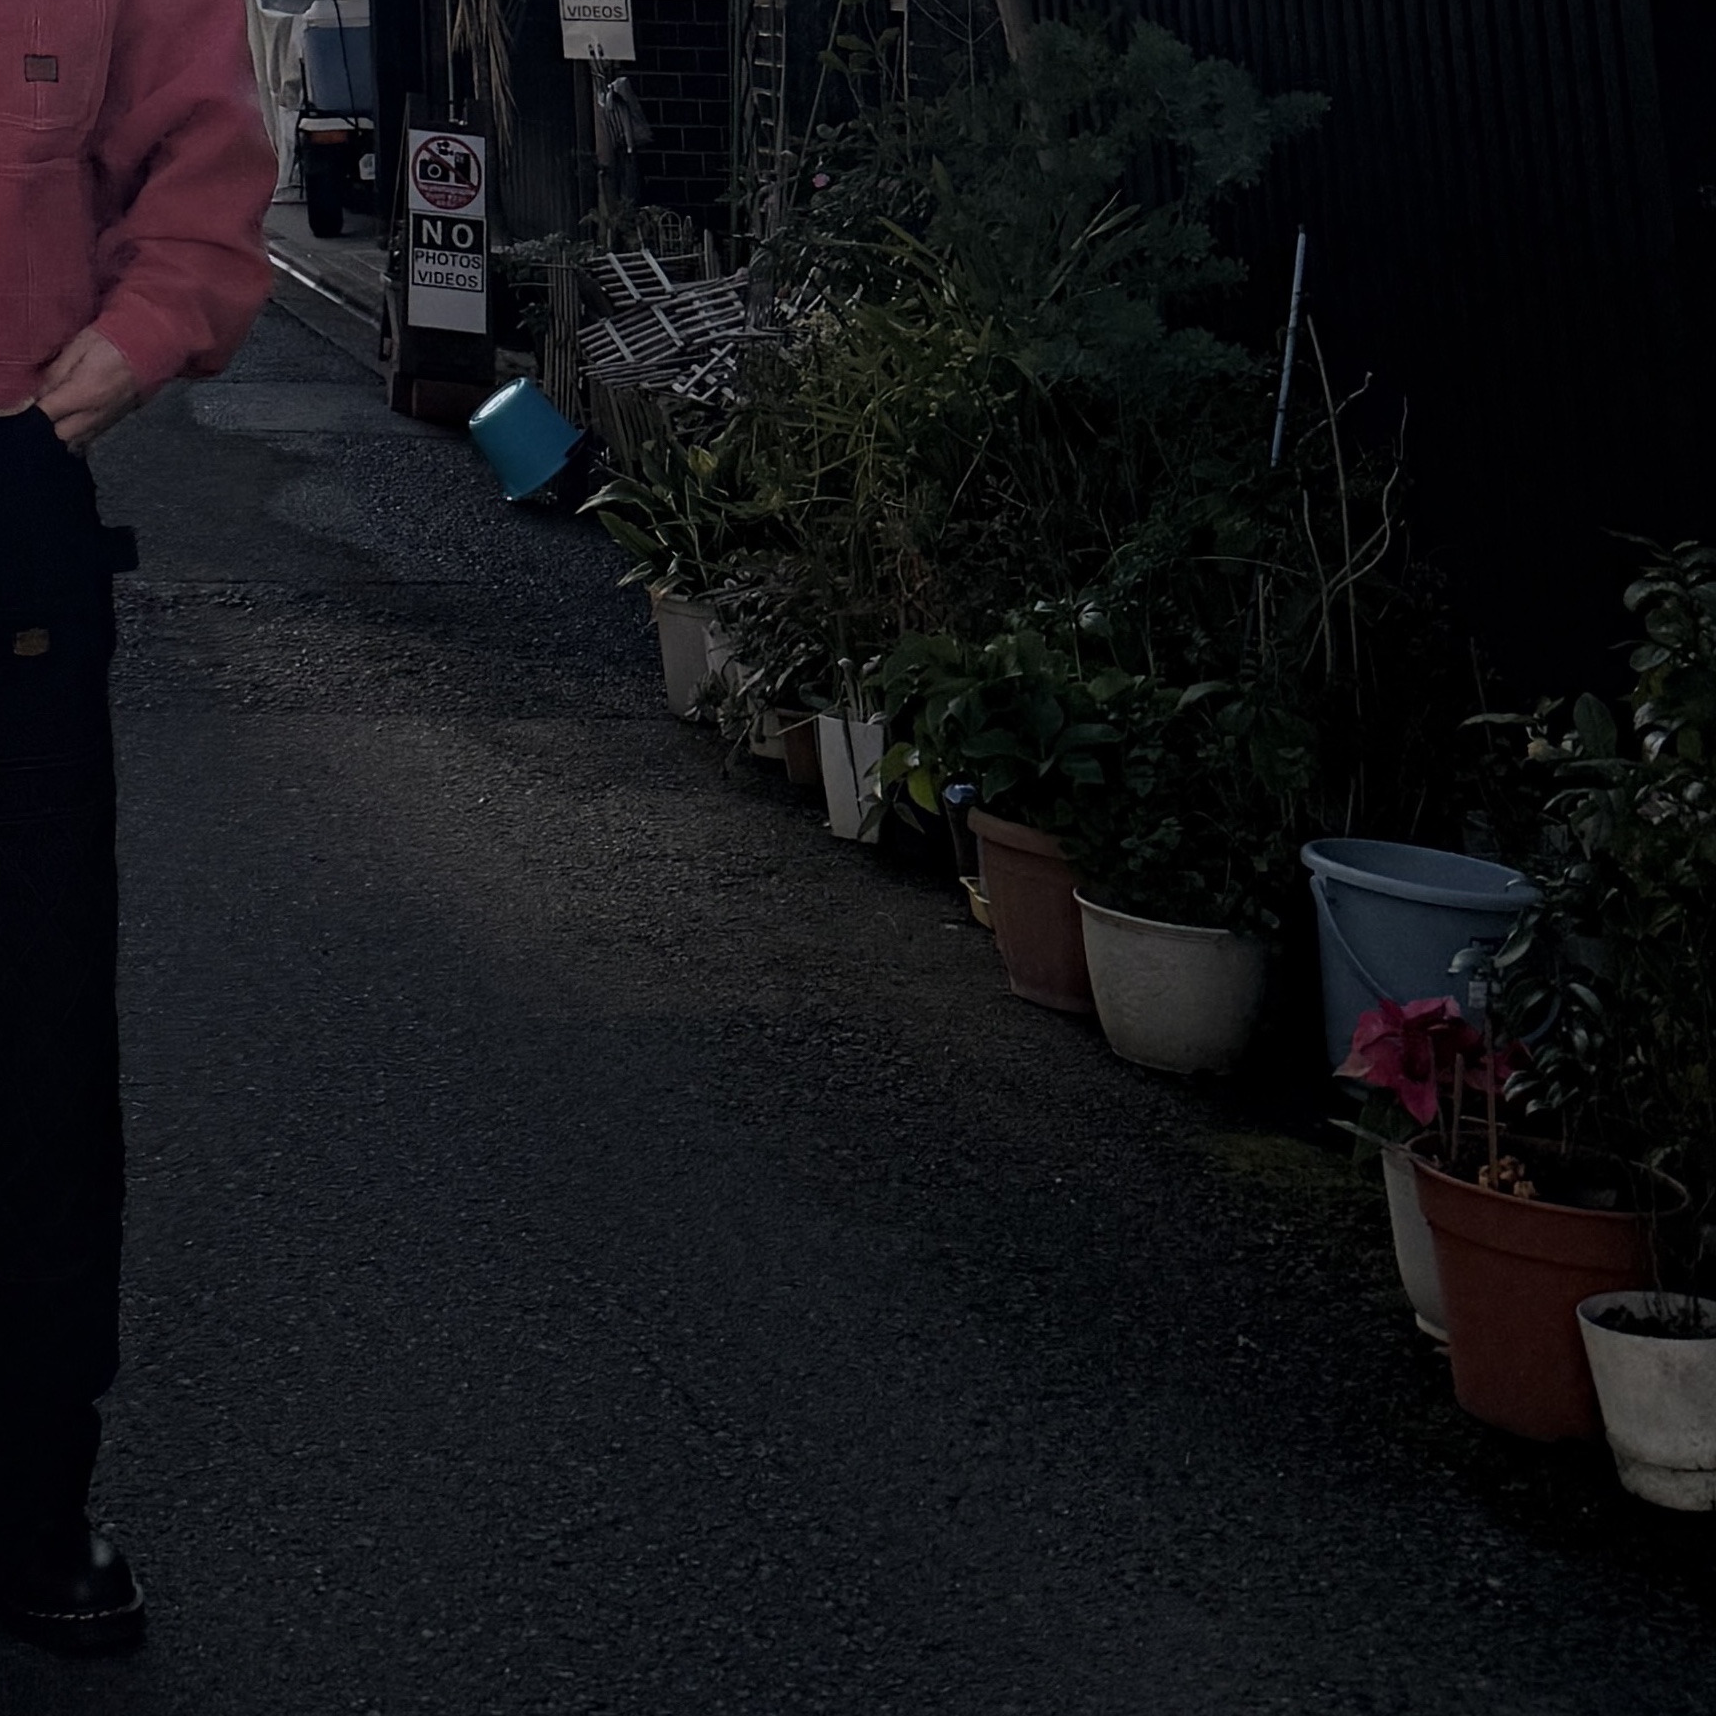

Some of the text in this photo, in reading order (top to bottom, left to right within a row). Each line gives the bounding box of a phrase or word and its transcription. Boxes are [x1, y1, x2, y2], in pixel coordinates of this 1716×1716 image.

[567, 5, 624, 19] VIDEOS
[421, 219, 475, 249] NO
[415, 250, 481, 269] PHOTOS
[417, 270, 478, 288] VIDEOS
